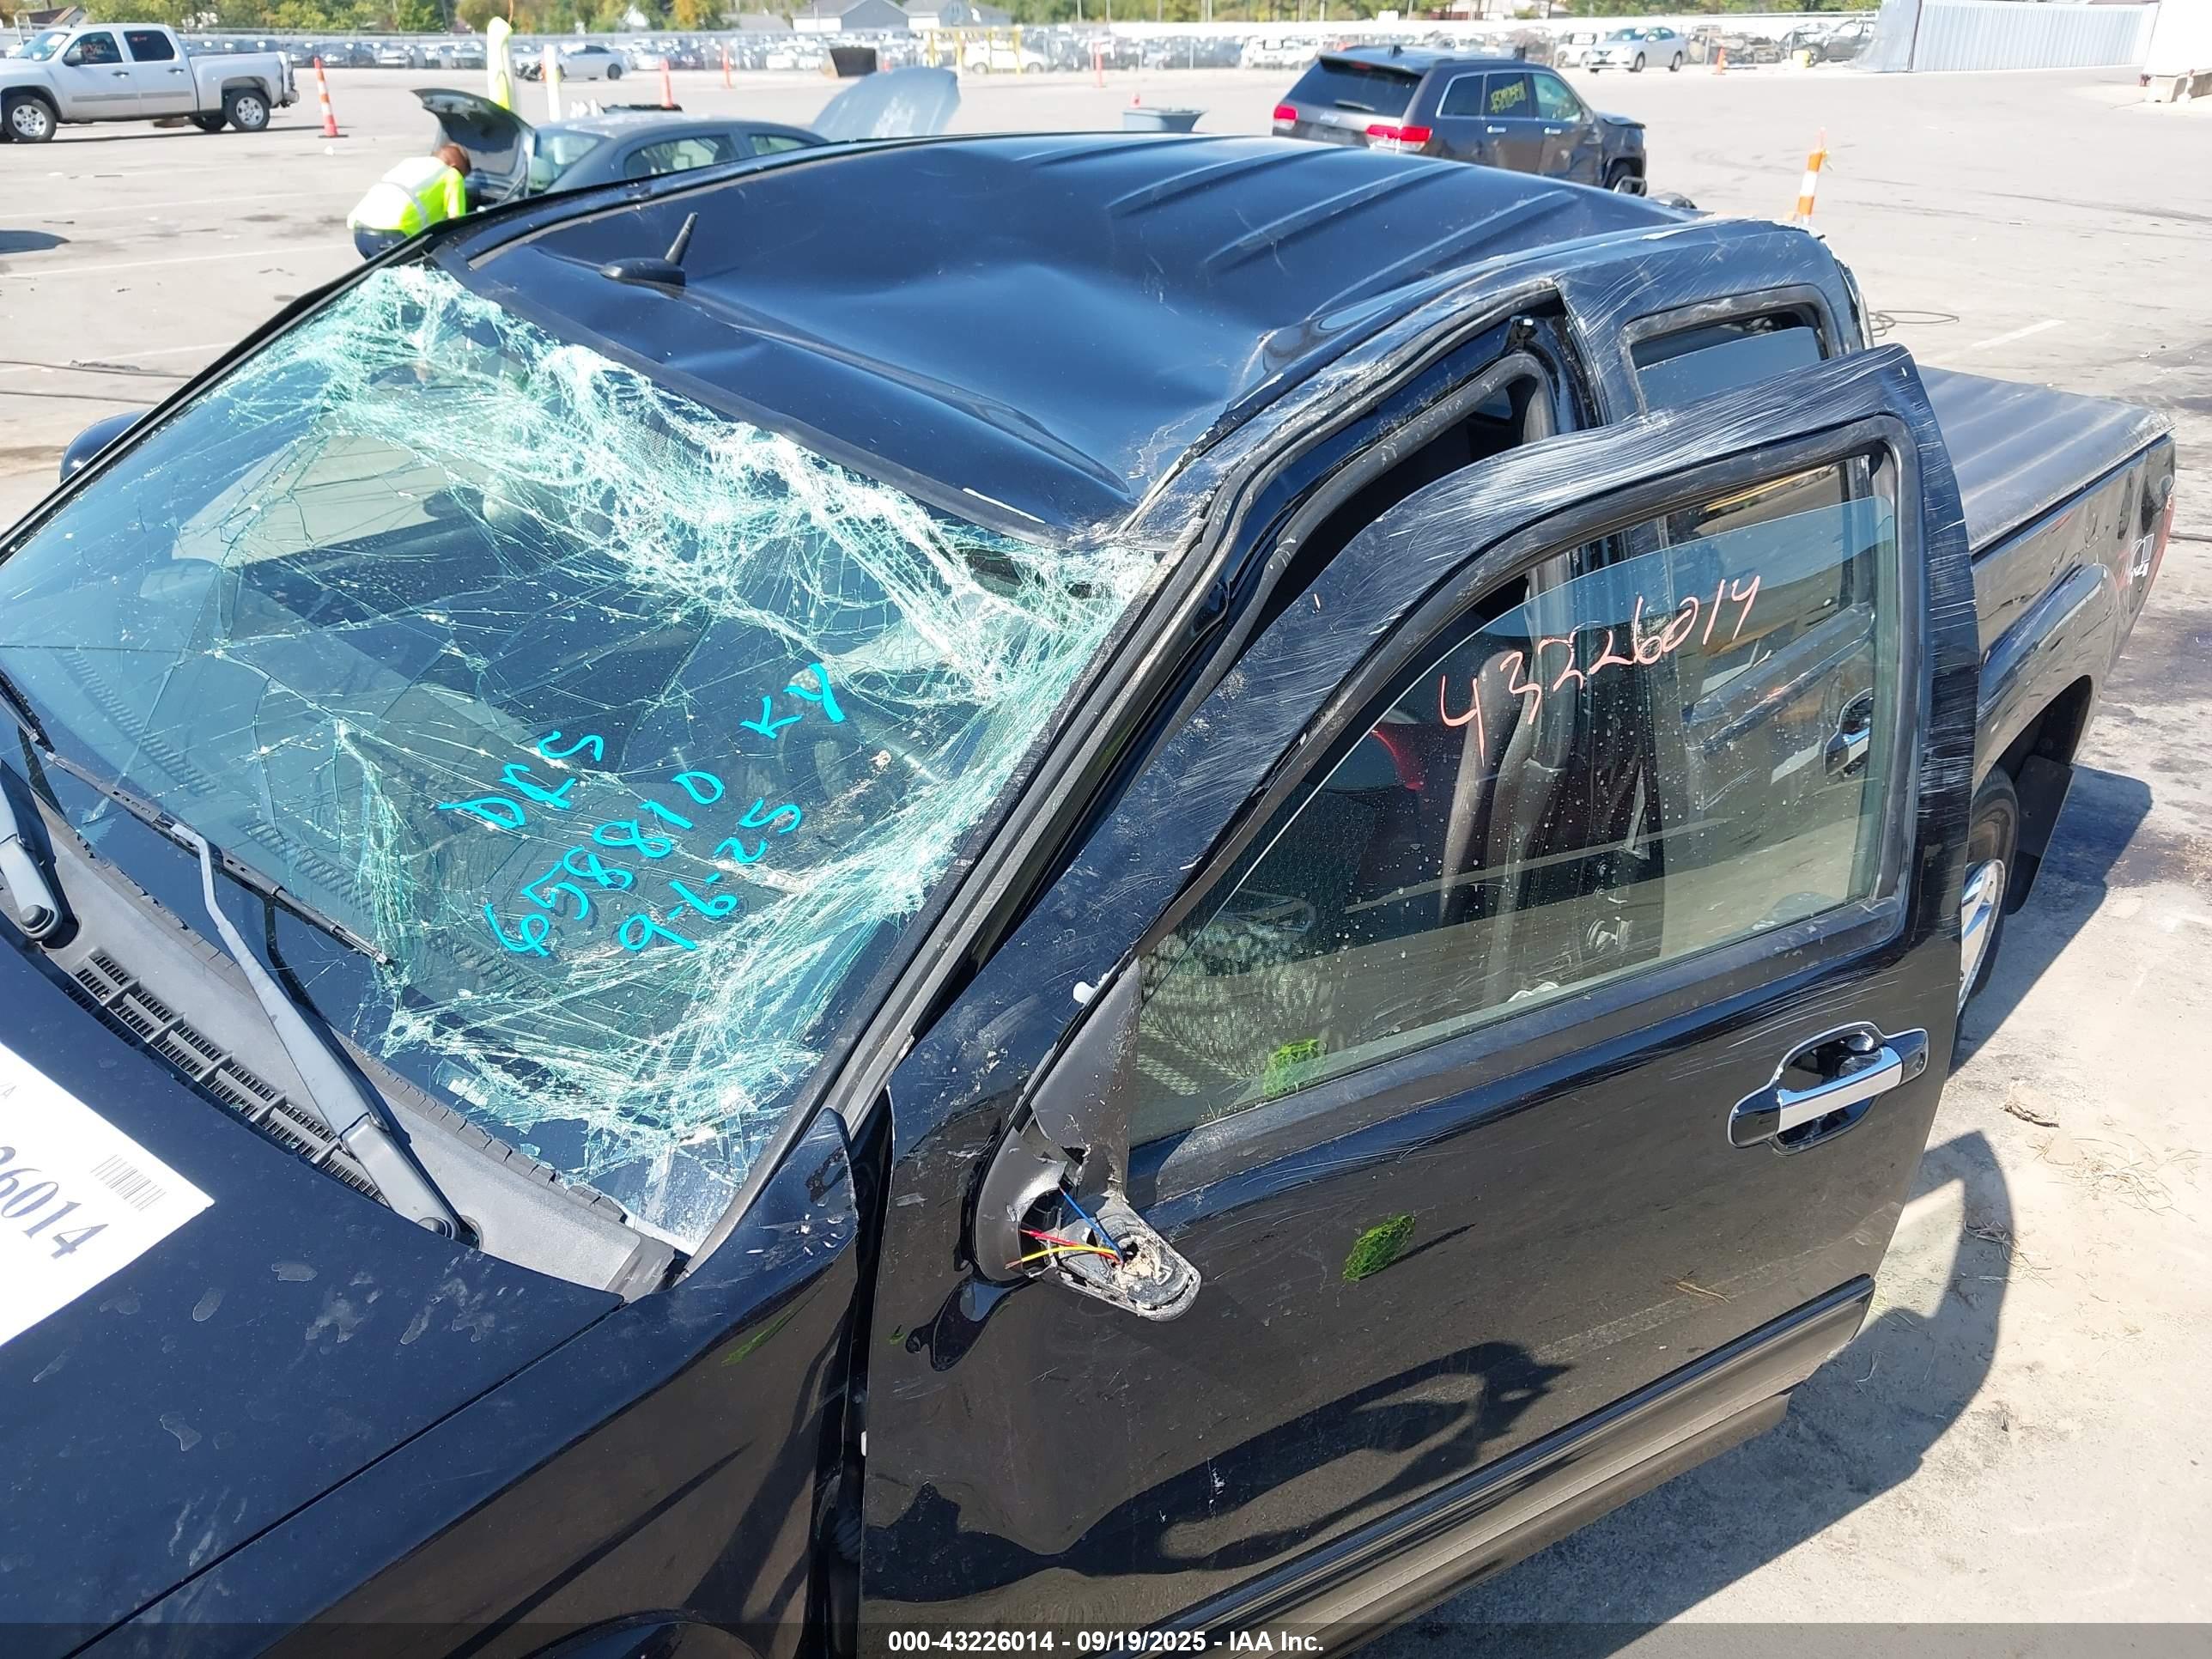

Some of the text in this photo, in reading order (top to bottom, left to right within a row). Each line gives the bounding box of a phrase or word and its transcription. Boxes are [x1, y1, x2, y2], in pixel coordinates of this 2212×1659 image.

[740, 662, 846, 739] KY
[1440, 574, 1761, 767] 43226014
[618, 799, 801, 951] 9-6-25
